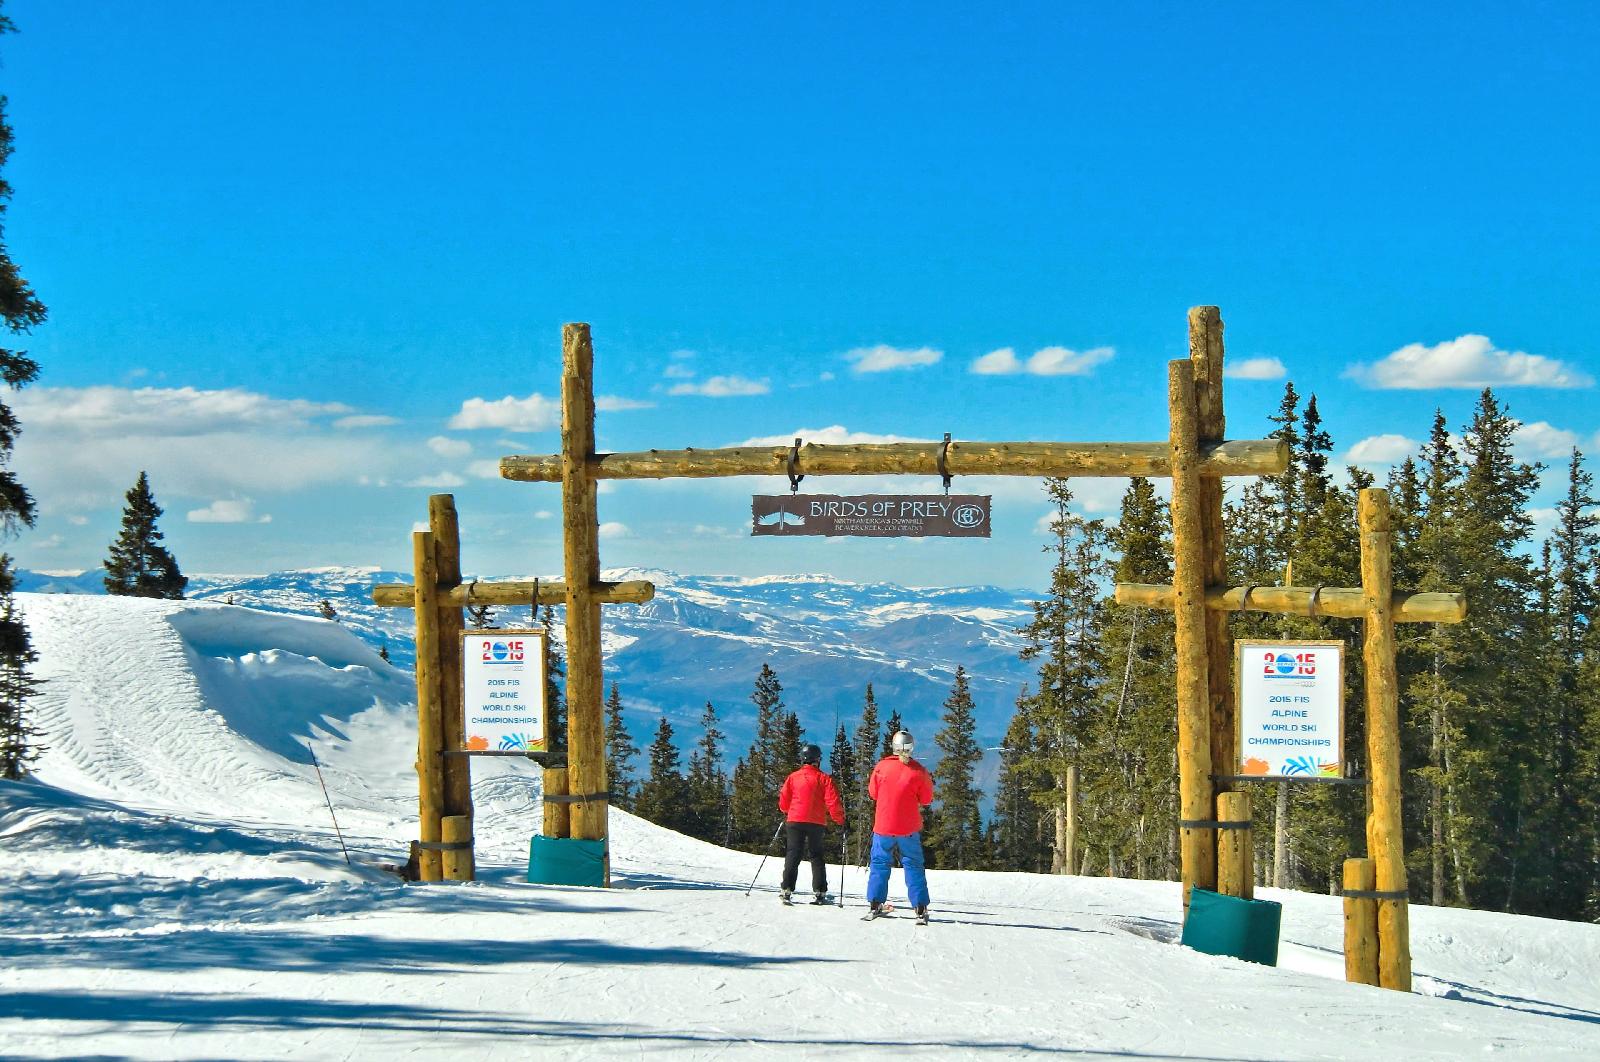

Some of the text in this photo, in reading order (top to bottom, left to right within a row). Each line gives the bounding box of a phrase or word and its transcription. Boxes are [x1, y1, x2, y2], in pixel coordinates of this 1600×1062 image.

[810, 501, 953, 517] BIRDS OF PREY
[483, 641, 524, 660] 2015
[1264, 652, 1316, 674] 2015
[1248, 737, 1331, 746] CHAMPIONSHIPS
